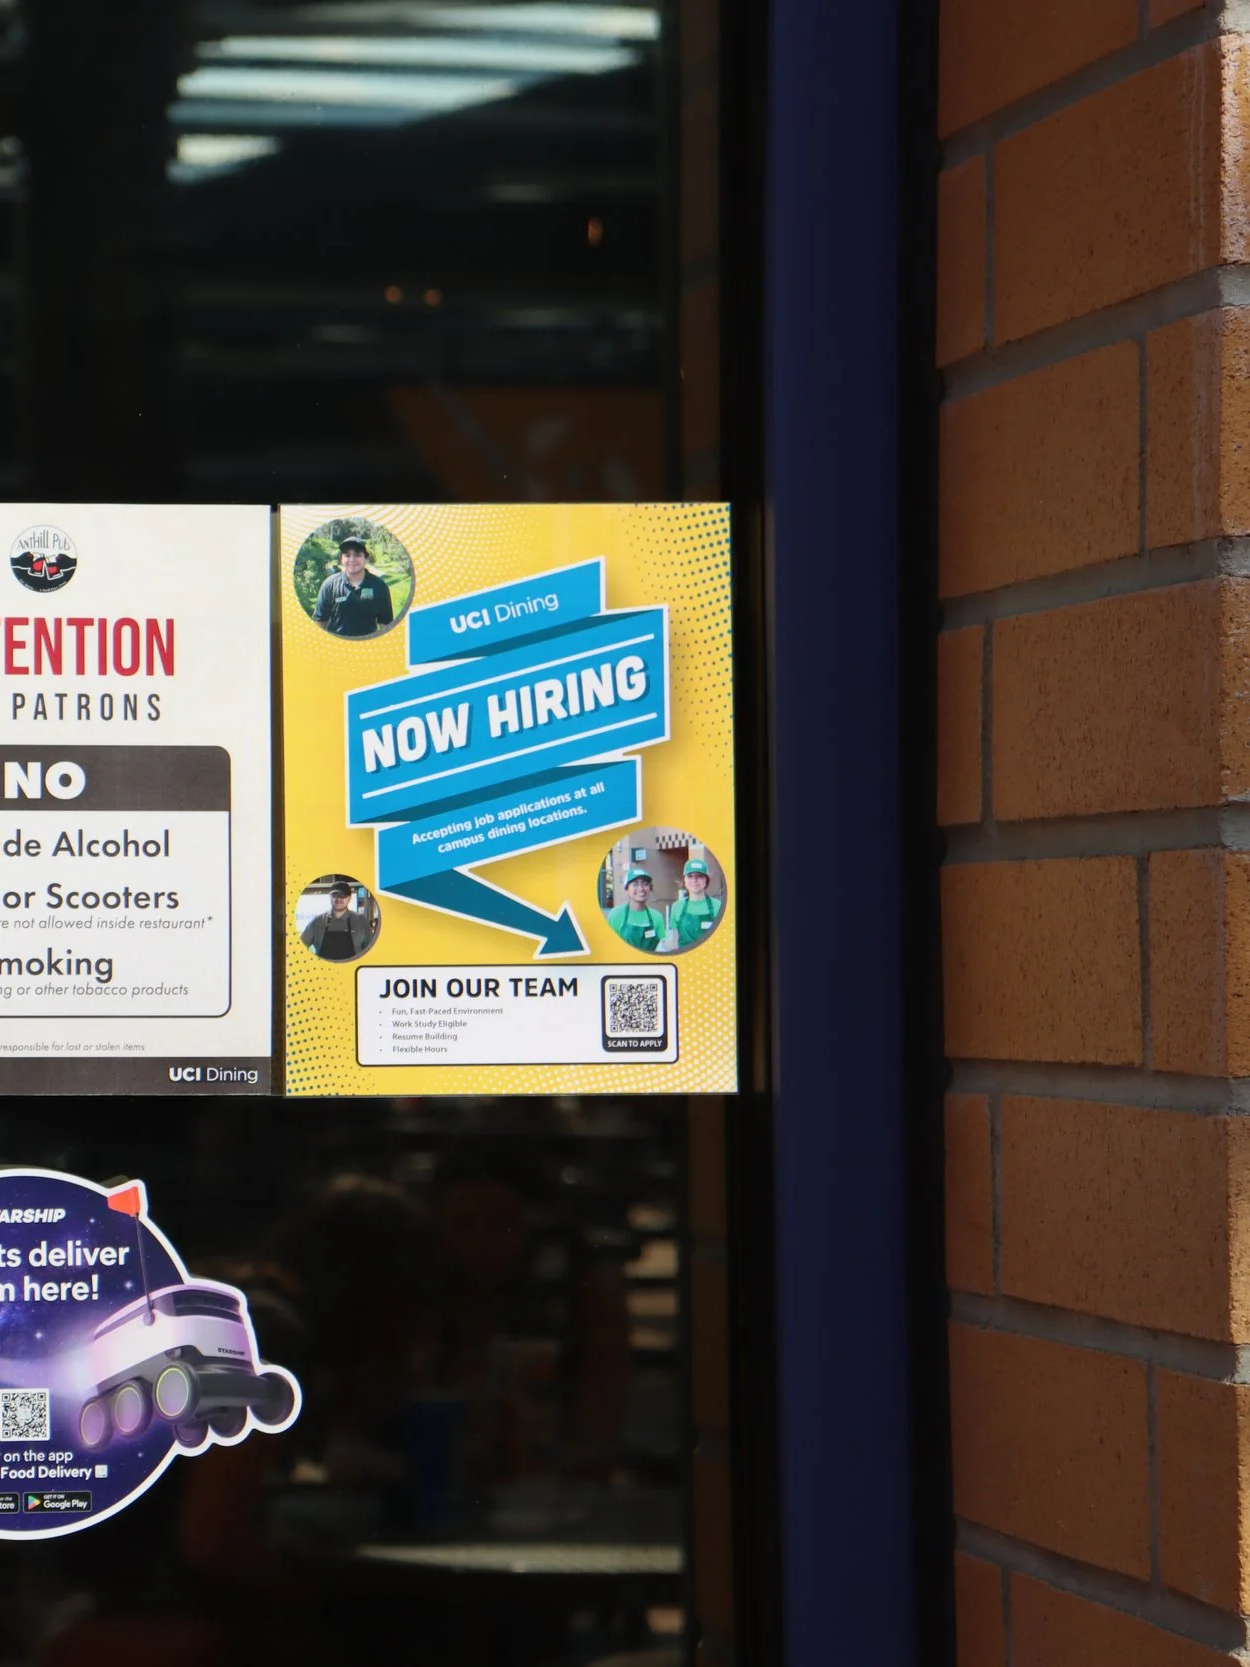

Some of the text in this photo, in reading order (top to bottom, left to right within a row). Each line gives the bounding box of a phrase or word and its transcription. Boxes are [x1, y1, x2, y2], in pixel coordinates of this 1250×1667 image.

[449, 593, 559, 633] UCI Dining
[13, 693, 160, 721] PATRONS
[362, 656, 647, 773] NOW HIRING
[4, 761, 86, 799] NO
[412, 781, 605, 844] Accepting job applications at all
[437, 805, 588, 853] campus dining locations.
[52, 829, 169, 857] Alcohol
[3, 892, 36, 909] or
[46, 883, 179, 909] Scooters
[14, 918, 35, 928] not
[39, 915, 93, 929] allowed
[97, 916, 135, 928] inside
[17, 987, 31, 995] or
[35, 982, 69, 995] other
[73, 982, 127, 996] tobacco
[132, 982, 188, 998] products
[379, 978, 578, 998] JOIN OUR TEAM
[392, 1008, 409, 1016] Fun,
[414, 1020, 436, 1029] Study
[438, 1020, 467, 1029] Eligible
[425, 1033, 457, 1041] Building
[607, 1040, 663, 1048] SCAN TO APPLY
[0, 1042, 49, 1053] responsible
[52, 1041, 64, 1051] for
[66, 1042, 81, 1051] lost
[96, 1042, 120, 1051] stolen
[169, 1067, 258, 1084] UCI Dining
[29, 1239, 129, 1267] deliver
[24, 1275, 99, 1302] here!
[4, 1453, 20, 1462] on
[23, 1449, 45, 1462] the
[48, 1452, 73, 1464] app
[1, 1466, 35, 1479] Food
[38, 1466, 92, 1480] Delivery
[43, 1499, 88, 1510] Google Play
